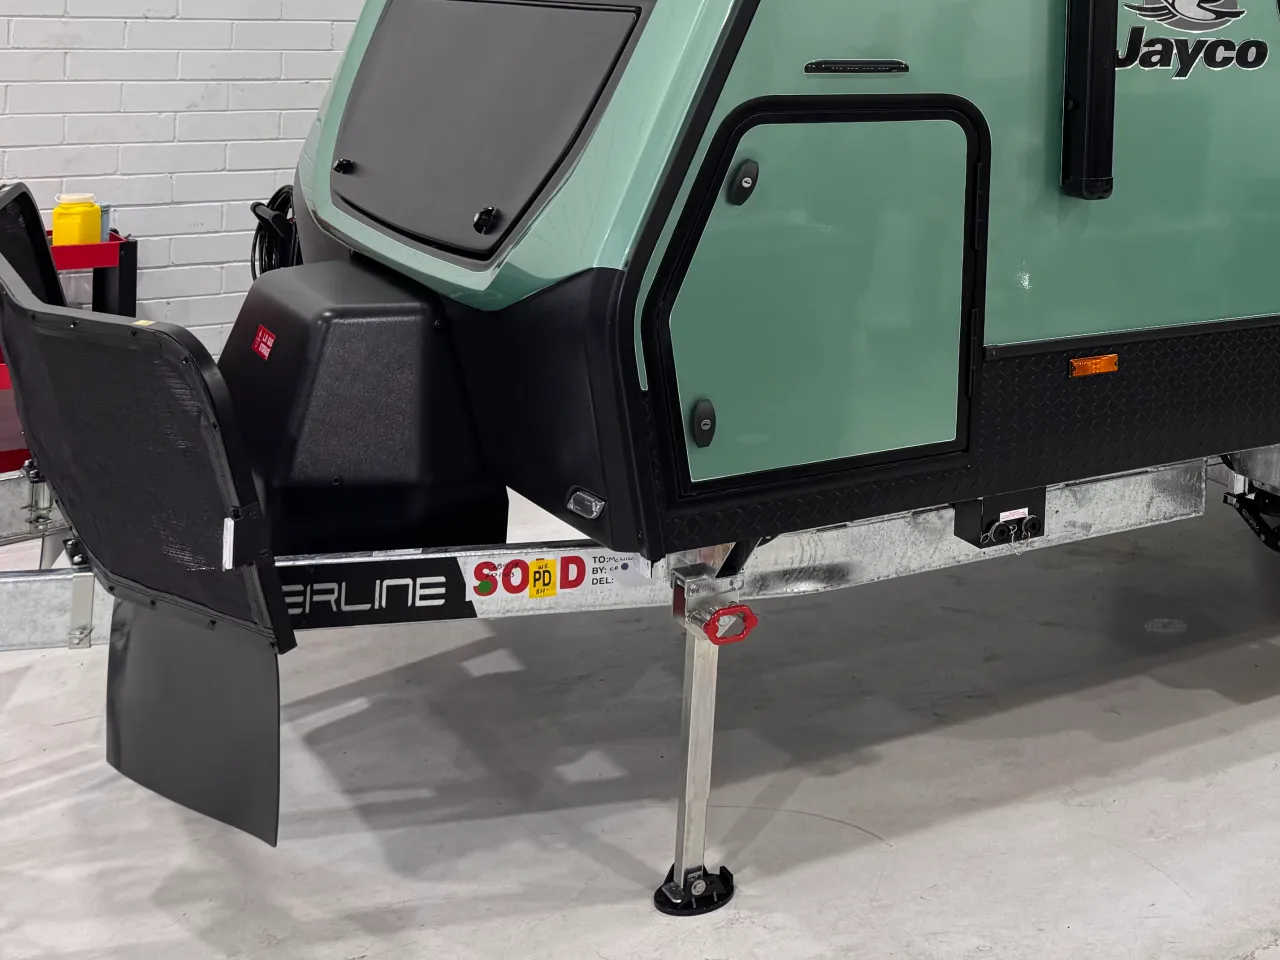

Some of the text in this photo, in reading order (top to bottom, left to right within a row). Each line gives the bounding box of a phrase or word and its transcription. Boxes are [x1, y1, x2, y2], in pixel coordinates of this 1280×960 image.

[1115, 25, 1270, 80] Jayco
[592, 556, 609, 565] TO:
[472, 555, 587, 597] SOD
[533, 569, 552, 588] PD
[592, 567, 607, 575] BY:
[591, 577, 615, 586] DEL:
[281, 576, 447, 615] ERLINE
